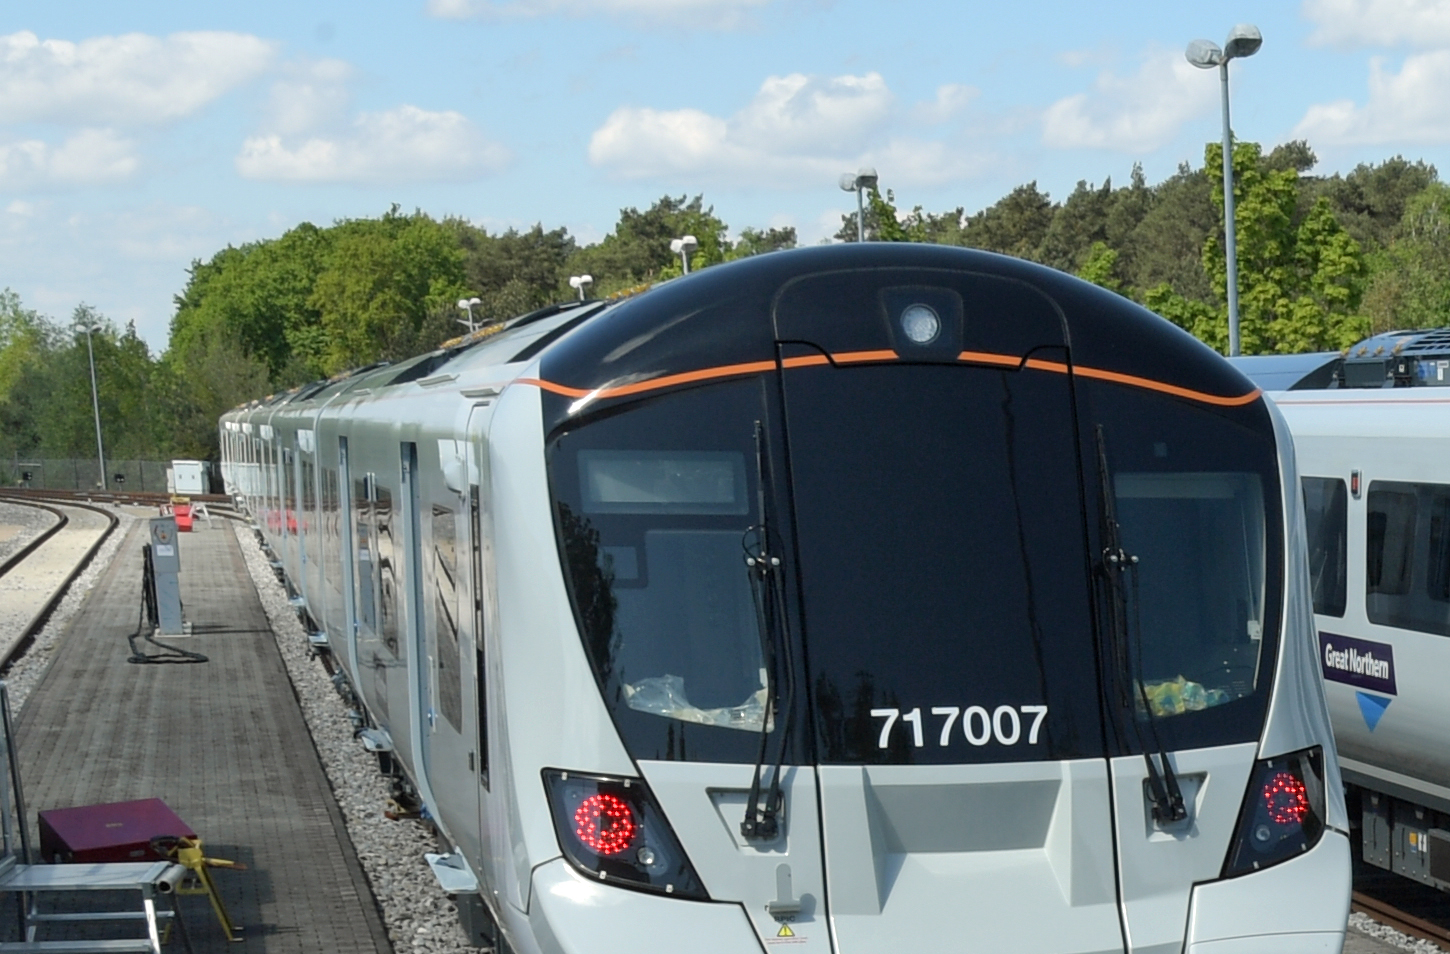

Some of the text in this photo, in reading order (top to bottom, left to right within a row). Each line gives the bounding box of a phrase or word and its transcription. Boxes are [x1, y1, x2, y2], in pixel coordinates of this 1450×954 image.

[1325, 643, 1389, 680] Great Northern
[870, 704, 1048, 749] 717007
